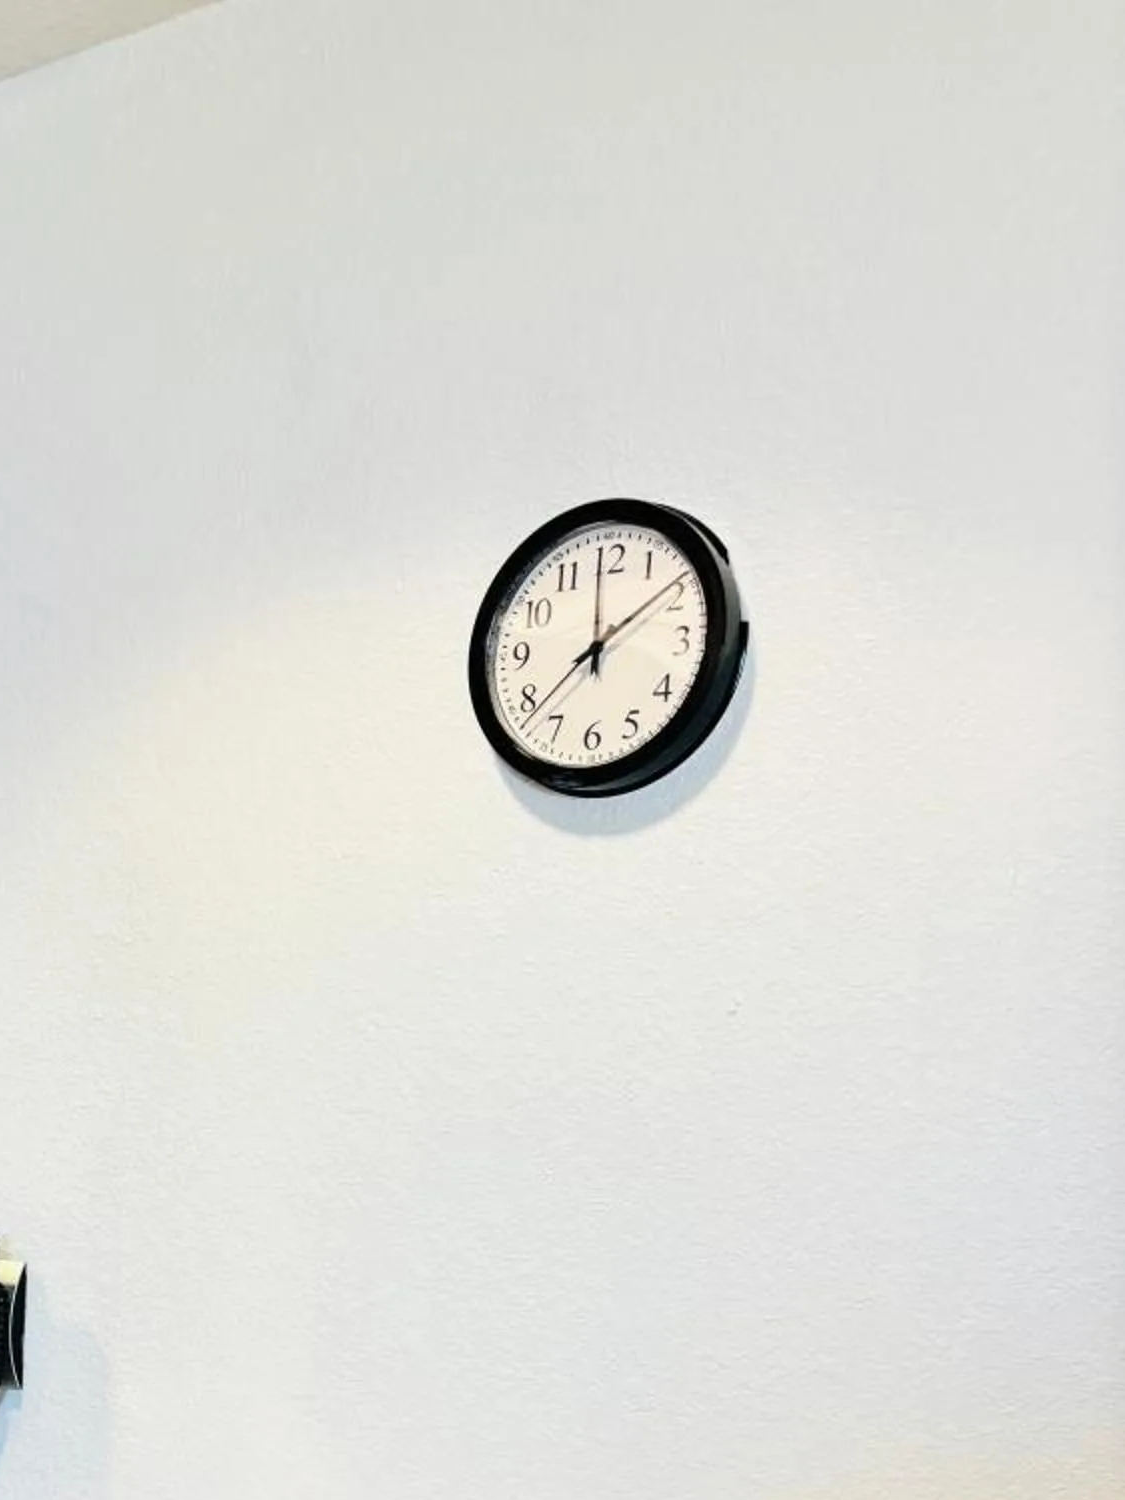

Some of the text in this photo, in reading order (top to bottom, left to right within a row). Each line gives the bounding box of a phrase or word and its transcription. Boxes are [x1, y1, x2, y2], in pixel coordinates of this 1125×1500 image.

[596, 543, 626, 574] 12
[644, 551, 653, 580] 1
[557, 561, 578, 592] 11
[666, 580, 684, 611] 2
[525, 598, 553, 629] 10
[513, 641, 530, 670] 9
[672, 625, 690, 656] 3
[520, 683, 537, 713] 8
[652, 673, 672, 702] 4
[547, 715, 564, 743] 7
[583, 720, 603, 750] 6
[621, 709, 641, 739] 5
